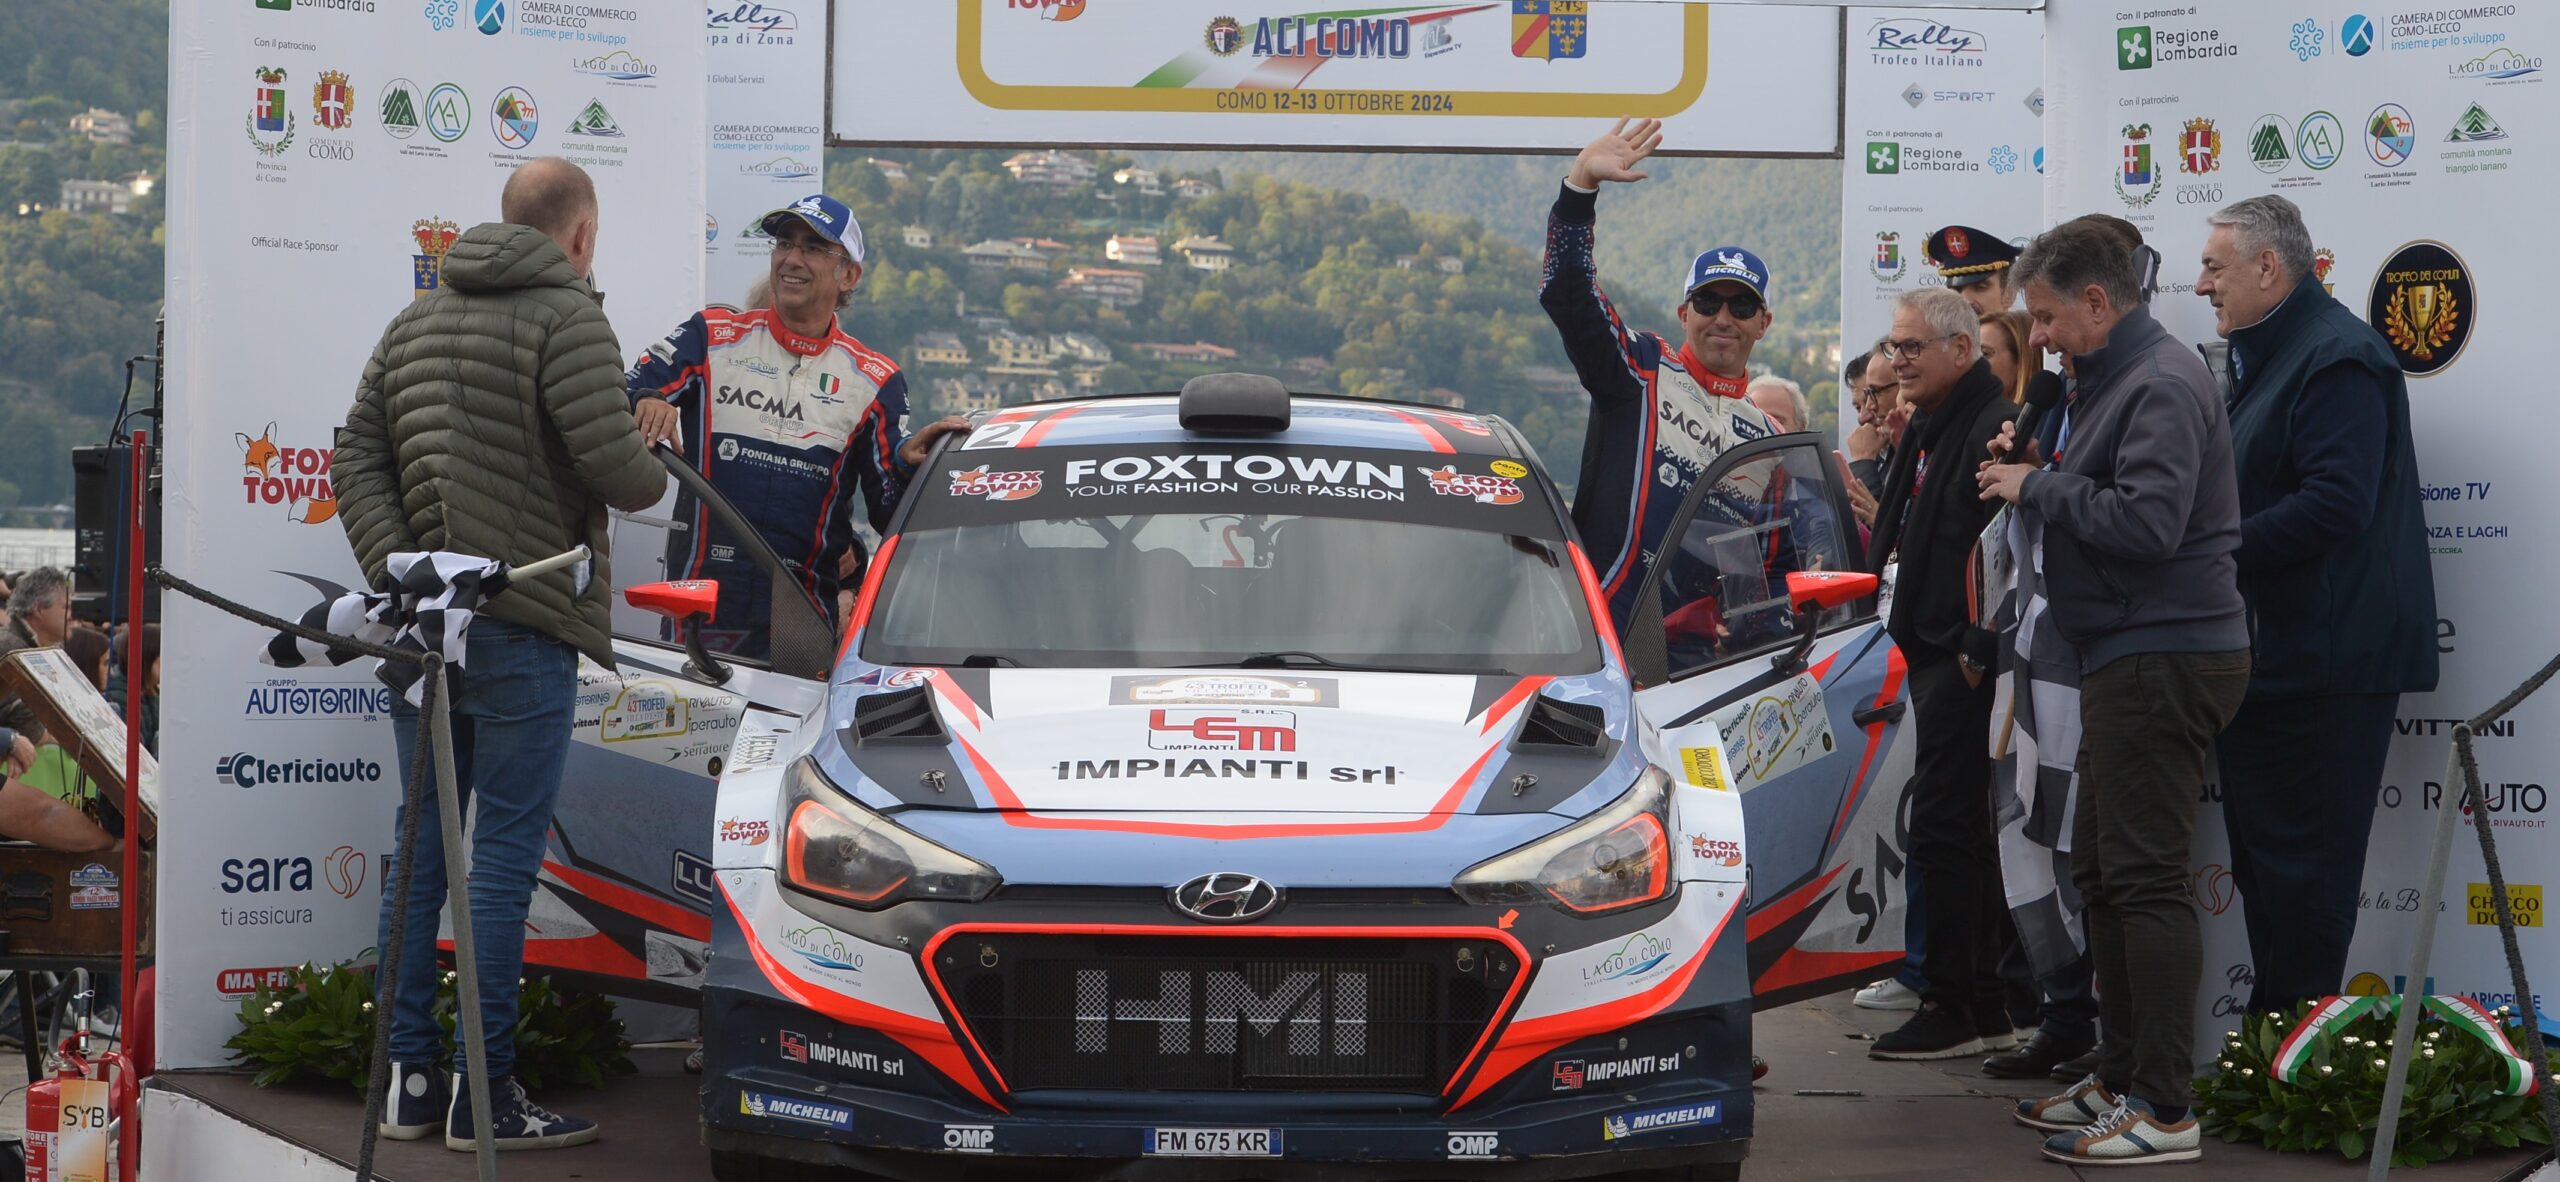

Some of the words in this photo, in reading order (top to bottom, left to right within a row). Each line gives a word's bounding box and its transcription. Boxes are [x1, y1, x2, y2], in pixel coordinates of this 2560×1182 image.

[521, 1, 562, 14] CAMERA
[564, 5, 574, 15] DI
[575, 6, 637, 21] COMMERCIO
[2116, 12, 2134, 21] Con
[2135, 11, 2141, 20] il
[2143, 7, 2186, 20] patronato
[2188, 6, 2197, 15] di
[2391, 11, 2434, 26] CAMERA
[2436, 11, 2447, 22] DI
[2448, 4, 2516, 21] COMMERCIO
[521, 13, 587, 28] COMO-LECCO
[520, 26, 557, 39] insieme
[559, 30, 574, 42] per
[576, 30, 585, 41] lo
[587, 32, 627, 46] sviluppo
[2391, 22, 2461, 38] COMO-LECCO
[253, 37, 271, 48] Con
[271, 39, 277, 48] il
[277, 40, 317, 52] patrocinio
[757, 33, 794, 45] Zona
[1252, 16, 1306, 57] ACI
[1315, 16, 1411, 60] COMO
[1878, 25, 1973, 54] Rally
[2155, 29, 2219, 47] Regione
[2391, 37, 2429, 51] insieme
[2432, 37, 2448, 50] per
[2450, 35, 2460, 46] lo
[2462, 32, 2506, 45] sviluppo
[1871, 53, 1918, 66] Trofeo
[1924, 53, 1984, 67] Italiano
[2156, 43, 2238, 62] Lombardia
[573, 58, 607, 71] LAGO
[610, 64, 619, 72] DI
[622, 62, 657, 75] COMO
[2448, 62, 2485, 75] LAGO
[2502, 57, 2543, 70] COMO
[712, 74, 737, 84] Global
[738, 74, 765, 85] Servizi
[1216, 91, 1267, 109] COMO
[1273, 92, 1317, 110] 12-13
[1324, 94, 1405, 111] OTTOBRE
[1411, 94, 1453, 112] 2024
[2119, 97, 2134, 107] Con
[2141, 94, 2180, 107] patrocinio
[713, 124, 751, 133] CAMERA
[752, 125, 762, 134] DI
[763, 125, 820, 134] COMMERCIO
[1866, 129, 1884, 137] Con
[1893, 131, 1933, 139] patronato
[309, 137, 342, 147] COMUNE
[713, 133, 774, 142] COMO-LECCO
[308, 144, 354, 161] COMO
[561, 142, 595, 152] comunità
[596, 144, 628, 154] montana
[713, 141, 747, 151] insieme
[748, 143, 762, 152] per
[764, 142, 772, 151] lo
[774, 142, 810, 152] sviluppo
[1903, 147, 1963, 161] Regione
[2440, 148, 2476, 160] comunità
[2477, 147, 2512, 157] montana
[256, 161, 287, 172] Provincia
[566, 155, 598, 166] triangolo
[1903, 160, 1979, 172] Lombardia
[2445, 163, 2479, 175] triangolo
[2480, 161, 2508, 172] lariano
[740, 164, 771, 173] LAGO
[785, 165, 818, 174] COMO
[2392, 170, 2417, 179] Montana
[255, 173, 263, 182] di
[265, 174, 287, 183] Como
[2370, 180, 2386, 188] Lario
[2176, 182, 2211, 192] COMUNE
[2176, 188, 2223, 205] COMO
[1868, 205, 1882, 213] Con
[1889, 205, 1923, 214] patrocinio
[251, 236, 282, 249] Official
[283, 238, 303, 250] Race
[304, 239, 339, 252] Sponsor
[1703, 265, 1760, 285] MICHELIN
[2385, 271, 2419, 284] TROFEO
[790, 338, 819, 352] HMI
[862, 362, 886, 378] OMP
[1712, 380, 1737, 393] HMI
[715, 384, 805, 421] SACMA
[969, 423, 1021, 448] 2
[280, 448, 335, 475] FOX
[740, 447, 788, 466] FONTANA
[789, 457, 831, 477] GRUPPO
[986, 470, 1044, 484] FOX
[1065, 454, 1405, 490] FOXTOWN
[950, 482, 1040, 496] TOWN
[1459, 475, 1516, 488] FOX
[1065, 484, 1128, 498] YOUR
[1133, 481, 1238, 494] FASHION
[1251, 482, 1302, 495] OUR
[1307, 484, 1405, 502] PASSION
[1431, 483, 1520, 497] TOWN
[2465, 482, 2491, 500] TV
[2456, 526, 2464, 538] E
[2467, 525, 2508, 538] LAGHI
[711, 547, 735, 560] OMP
[2438, 547, 2463, 555] ICCREA
[266, 679, 298, 687] GRUPPO
[638, 697, 666, 712] TROFEO
[688, 695, 733, 708] RIVAUTO
[688, 714, 737, 735] iperauto
[683, 741, 730, 758] Serratore
[233, 752, 381, 788] Clericiauto
[1057, 758, 1309, 781] IMPIANTI
[1329, 765, 1397, 785] srl
[738, 820, 769, 830] FOX
[720, 828, 769, 842] TOWN
[1708, 840, 1740, 850] FOX
[1692, 848, 1741, 859] TOWN
[220, 856, 313, 894] sara
[220, 907, 233, 927] ti
[237, 906, 313, 927] assicura
[779, 924, 807, 949] LAGO
[810, 943, 819, 953] DI
[823, 943, 865, 968] COMO
[1582, 956, 1624, 981] LAGO
[1629, 955, 1638, 966] DI
[1641, 937, 1672, 961] COMO
[1075, 969, 1368, 1056] HMI
[809, 1041, 878, 1072] IMPIANTI
[883, 1058, 904, 1076] srl
[1587, 1055, 1656, 1082] IMPIANTI
[1658, 1052, 1680, 1072] srl
[769, 1099, 849, 1124] MICHELIN
[1632, 1105, 1716, 1129] MICHELIN
[943, 1128, 995, 1149] OMP
[1157, 1131, 1188, 1152] FM
[1194, 1131, 1231, 1152] 675
[1236, 1131, 1268, 1152] KR
[1447, 1136, 1498, 1156] OMP
